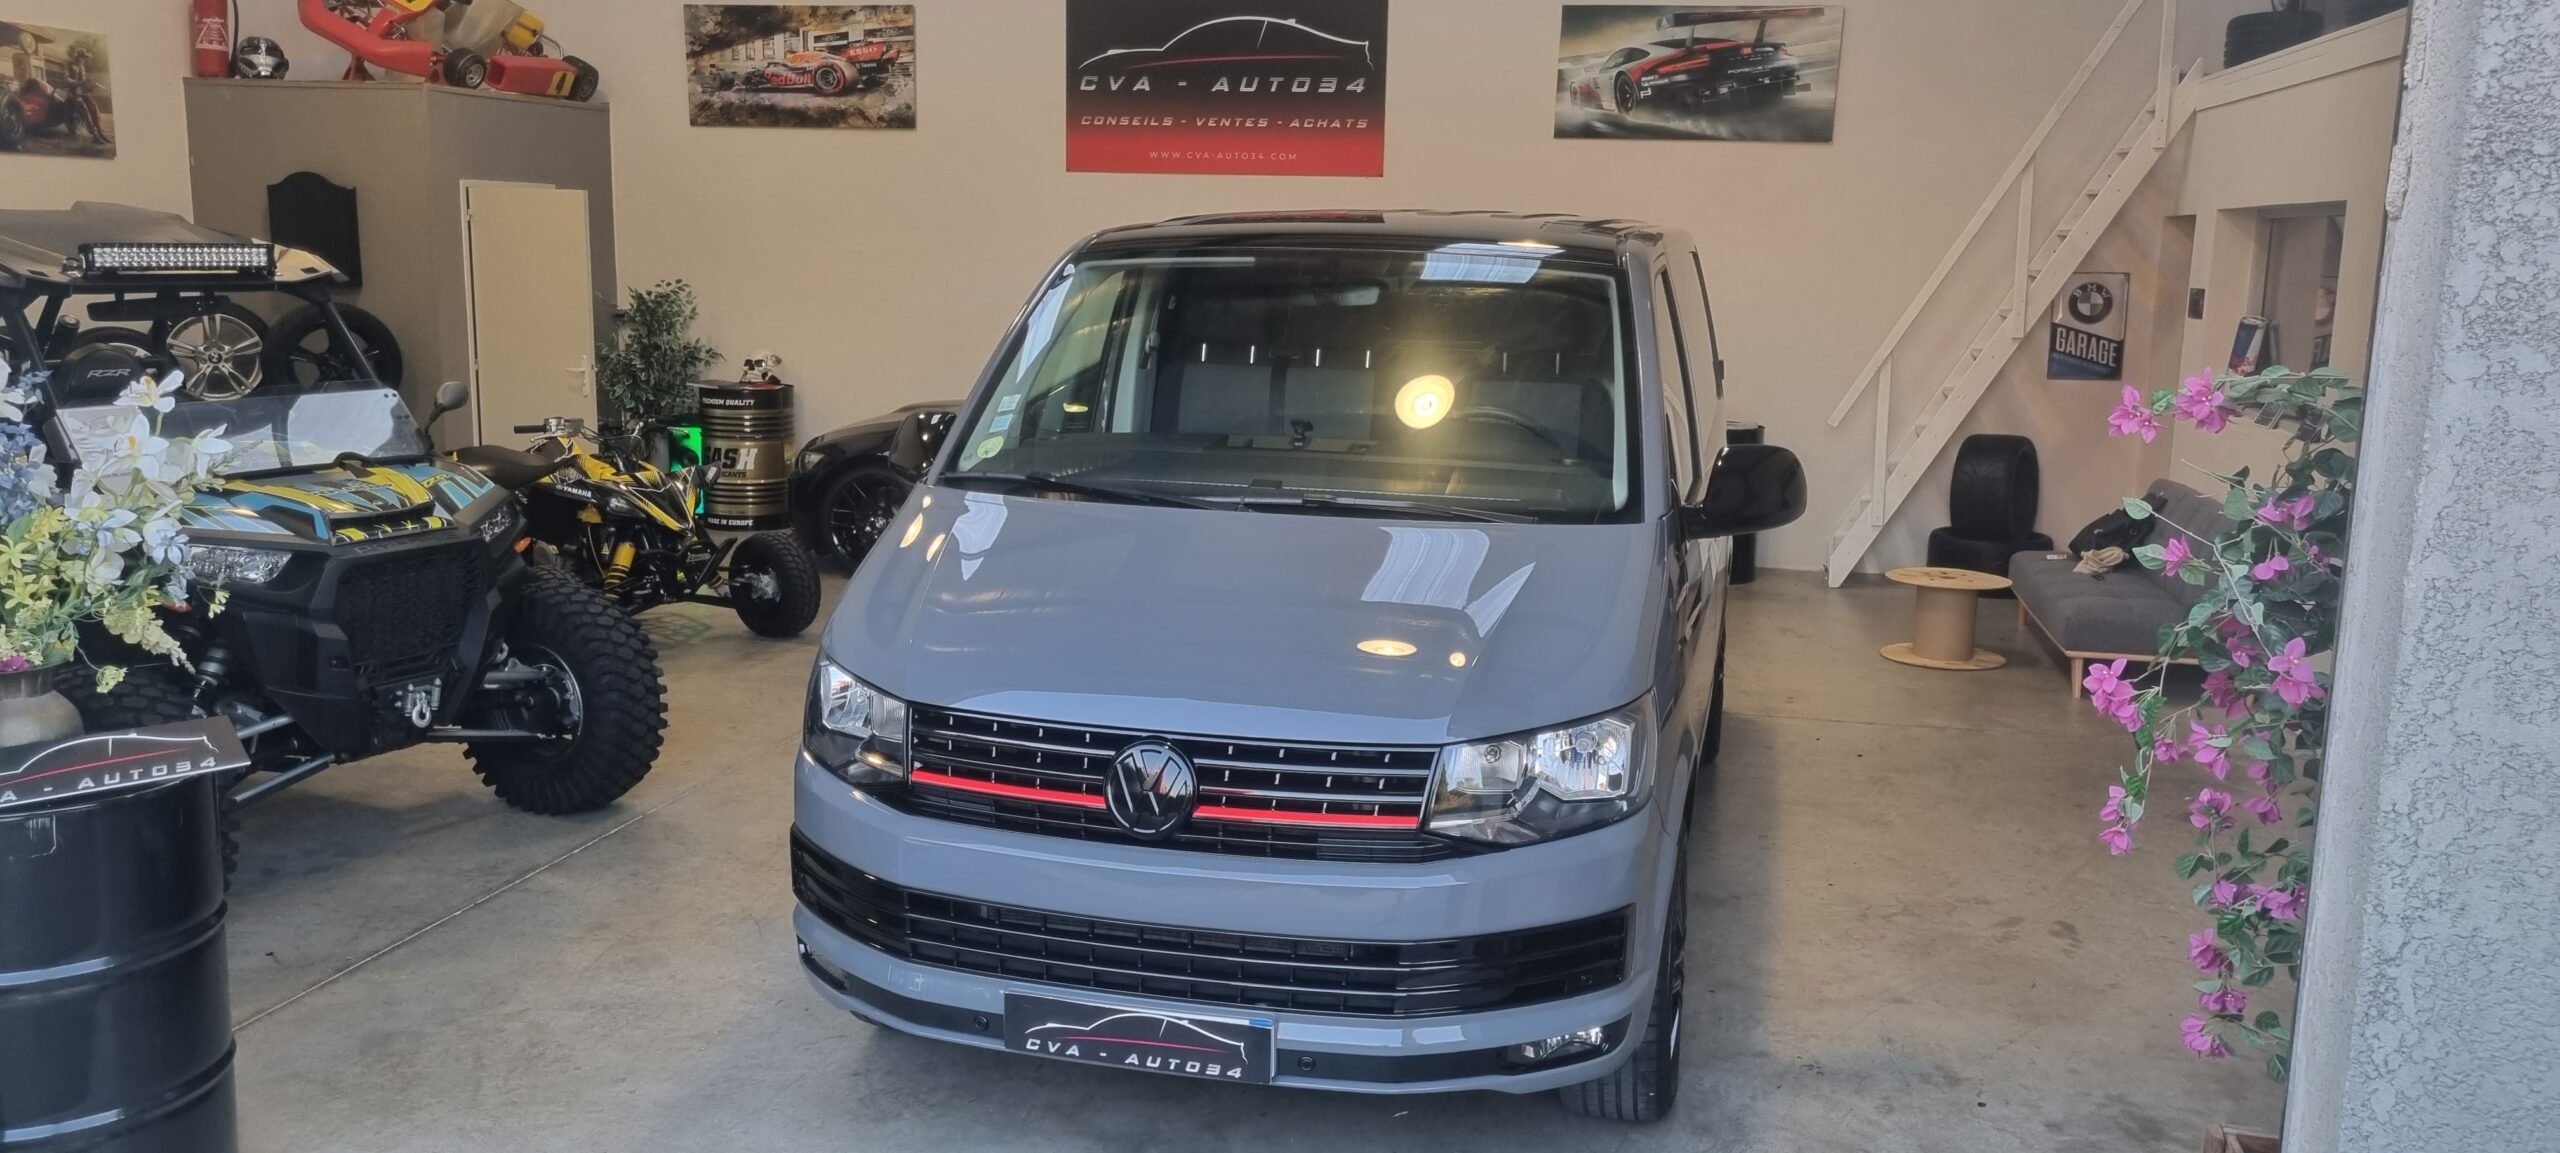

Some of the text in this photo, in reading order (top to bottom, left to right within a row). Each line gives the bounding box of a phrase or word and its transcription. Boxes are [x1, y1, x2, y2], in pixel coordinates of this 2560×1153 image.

[1080, 76, 1150, 91] CVA
[1211, 76, 1365, 93] AUTO34
[1081, 116, 1173, 126] CONSEILS
[1196, 117, 1269, 127] VENTES
[1289, 118, 1368, 128] ACHATS
[1149, 151, 1297, 160] WWW.CVA-AUTO34.COM
[2072, 284, 2111, 298] BMW
[2055, 327, 2118, 368] GARAGE
[86, 368, 132, 379] RZR
[563, 485, 592, 498] YAMAHA
[0, 789, 18, 801] A
[78, 756, 216, 790] AUTO34
[1026, 1038, 1080, 1056] CVA
[1125, 1053, 1242, 1079] AUTO34
